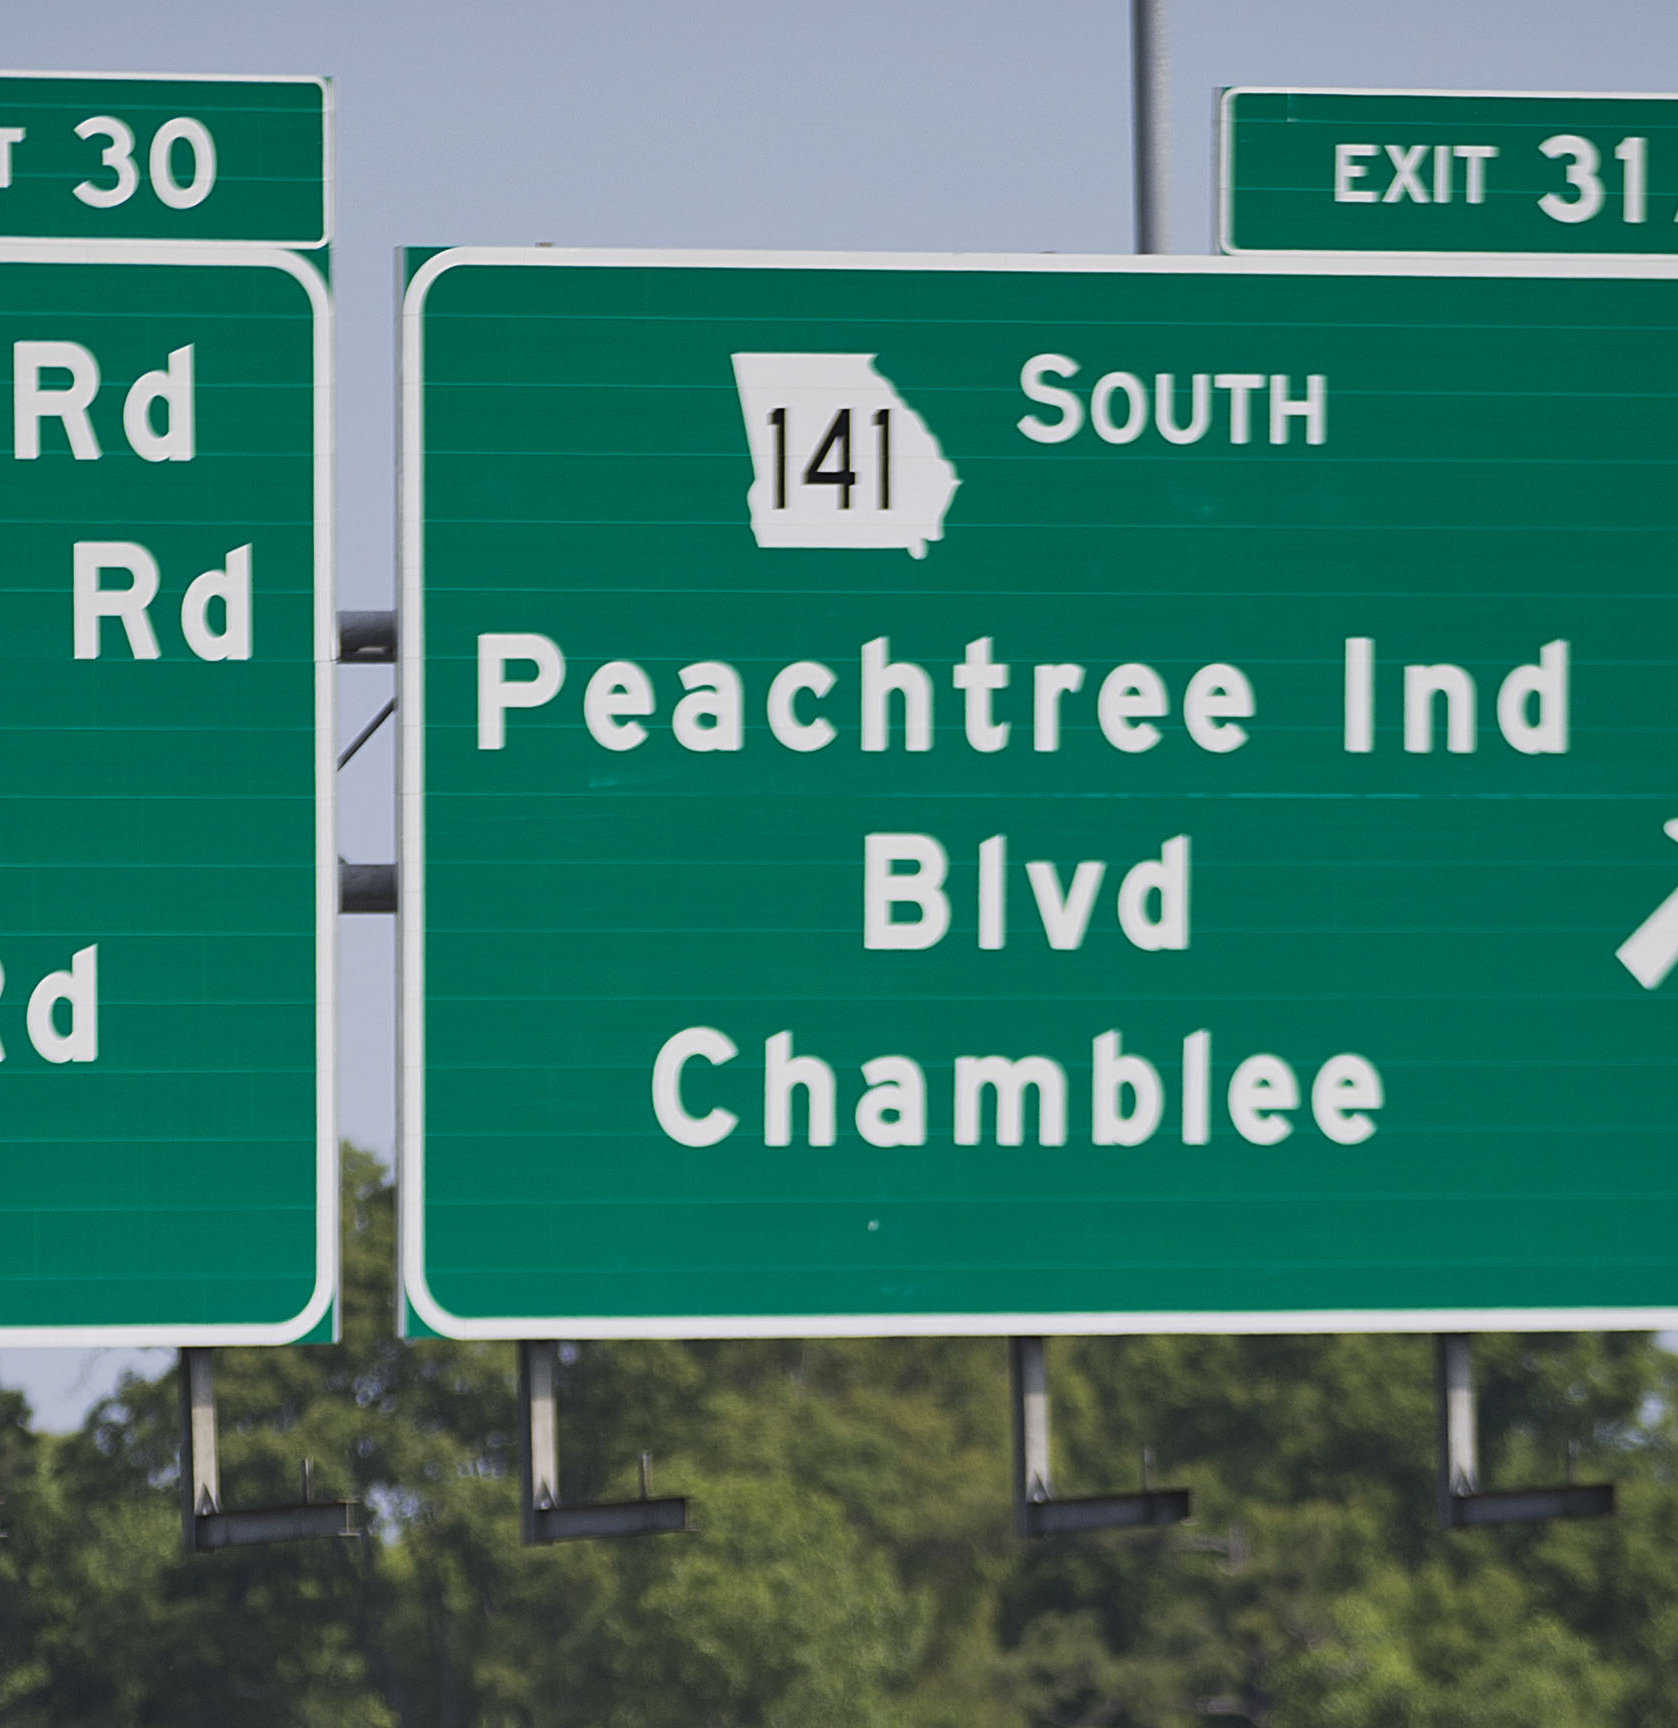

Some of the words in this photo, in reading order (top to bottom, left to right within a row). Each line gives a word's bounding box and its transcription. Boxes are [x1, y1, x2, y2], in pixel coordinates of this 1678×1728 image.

[72, 116, 217, 209] 30
[1334, 144, 1498, 205] EXIT
[12, 340, 195, 463] Rd
[1016, 352, 1327, 446] SOUTH
[765, 407, 893, 512] 141
[72, 540, 253, 663] Rd
[476, 632, 1257, 754] Peachtree
[1343, 636, 1572, 755] Ind
[863, 832, 1193, 952] Blvd
[651, 1026, 1385, 1148] Chamblee
